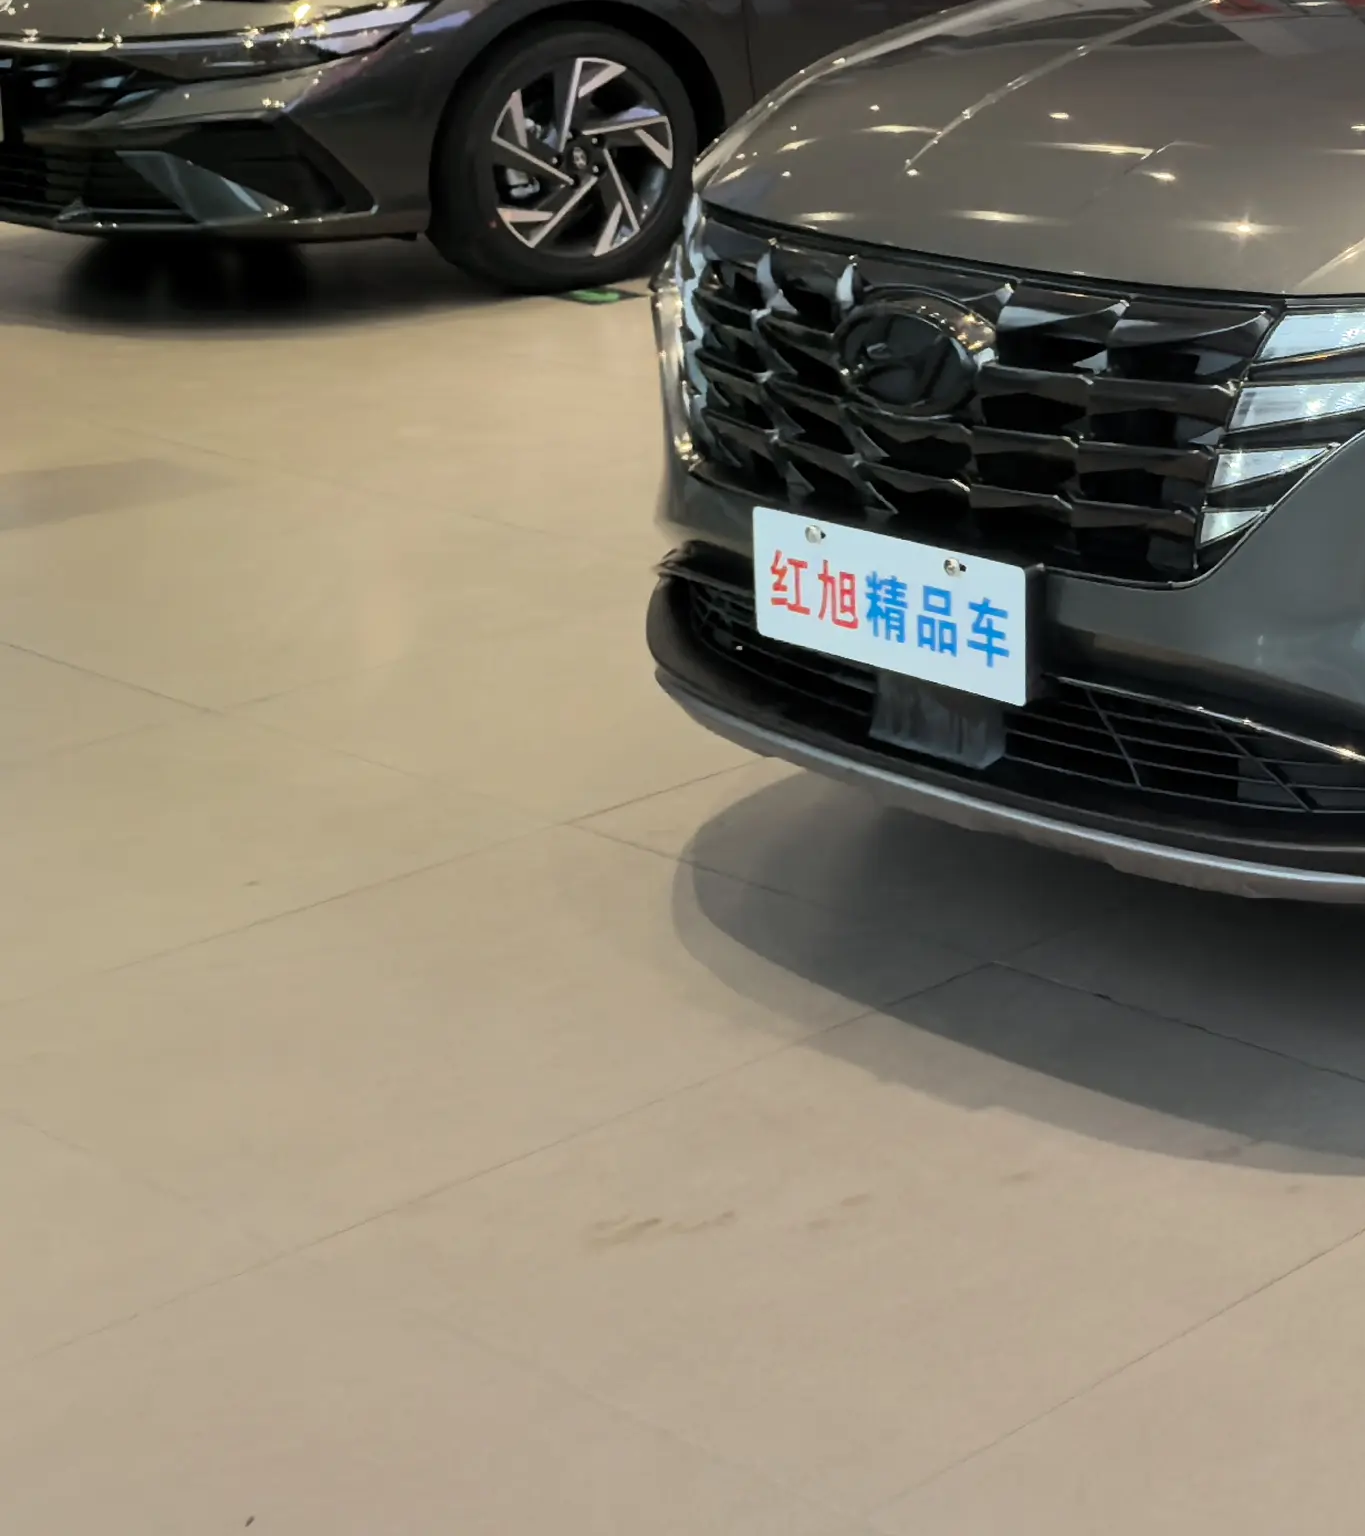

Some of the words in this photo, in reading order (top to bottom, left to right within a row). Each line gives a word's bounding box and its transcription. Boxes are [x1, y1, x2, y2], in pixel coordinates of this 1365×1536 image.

[770, 549, 1010, 669] 红旭精品车
